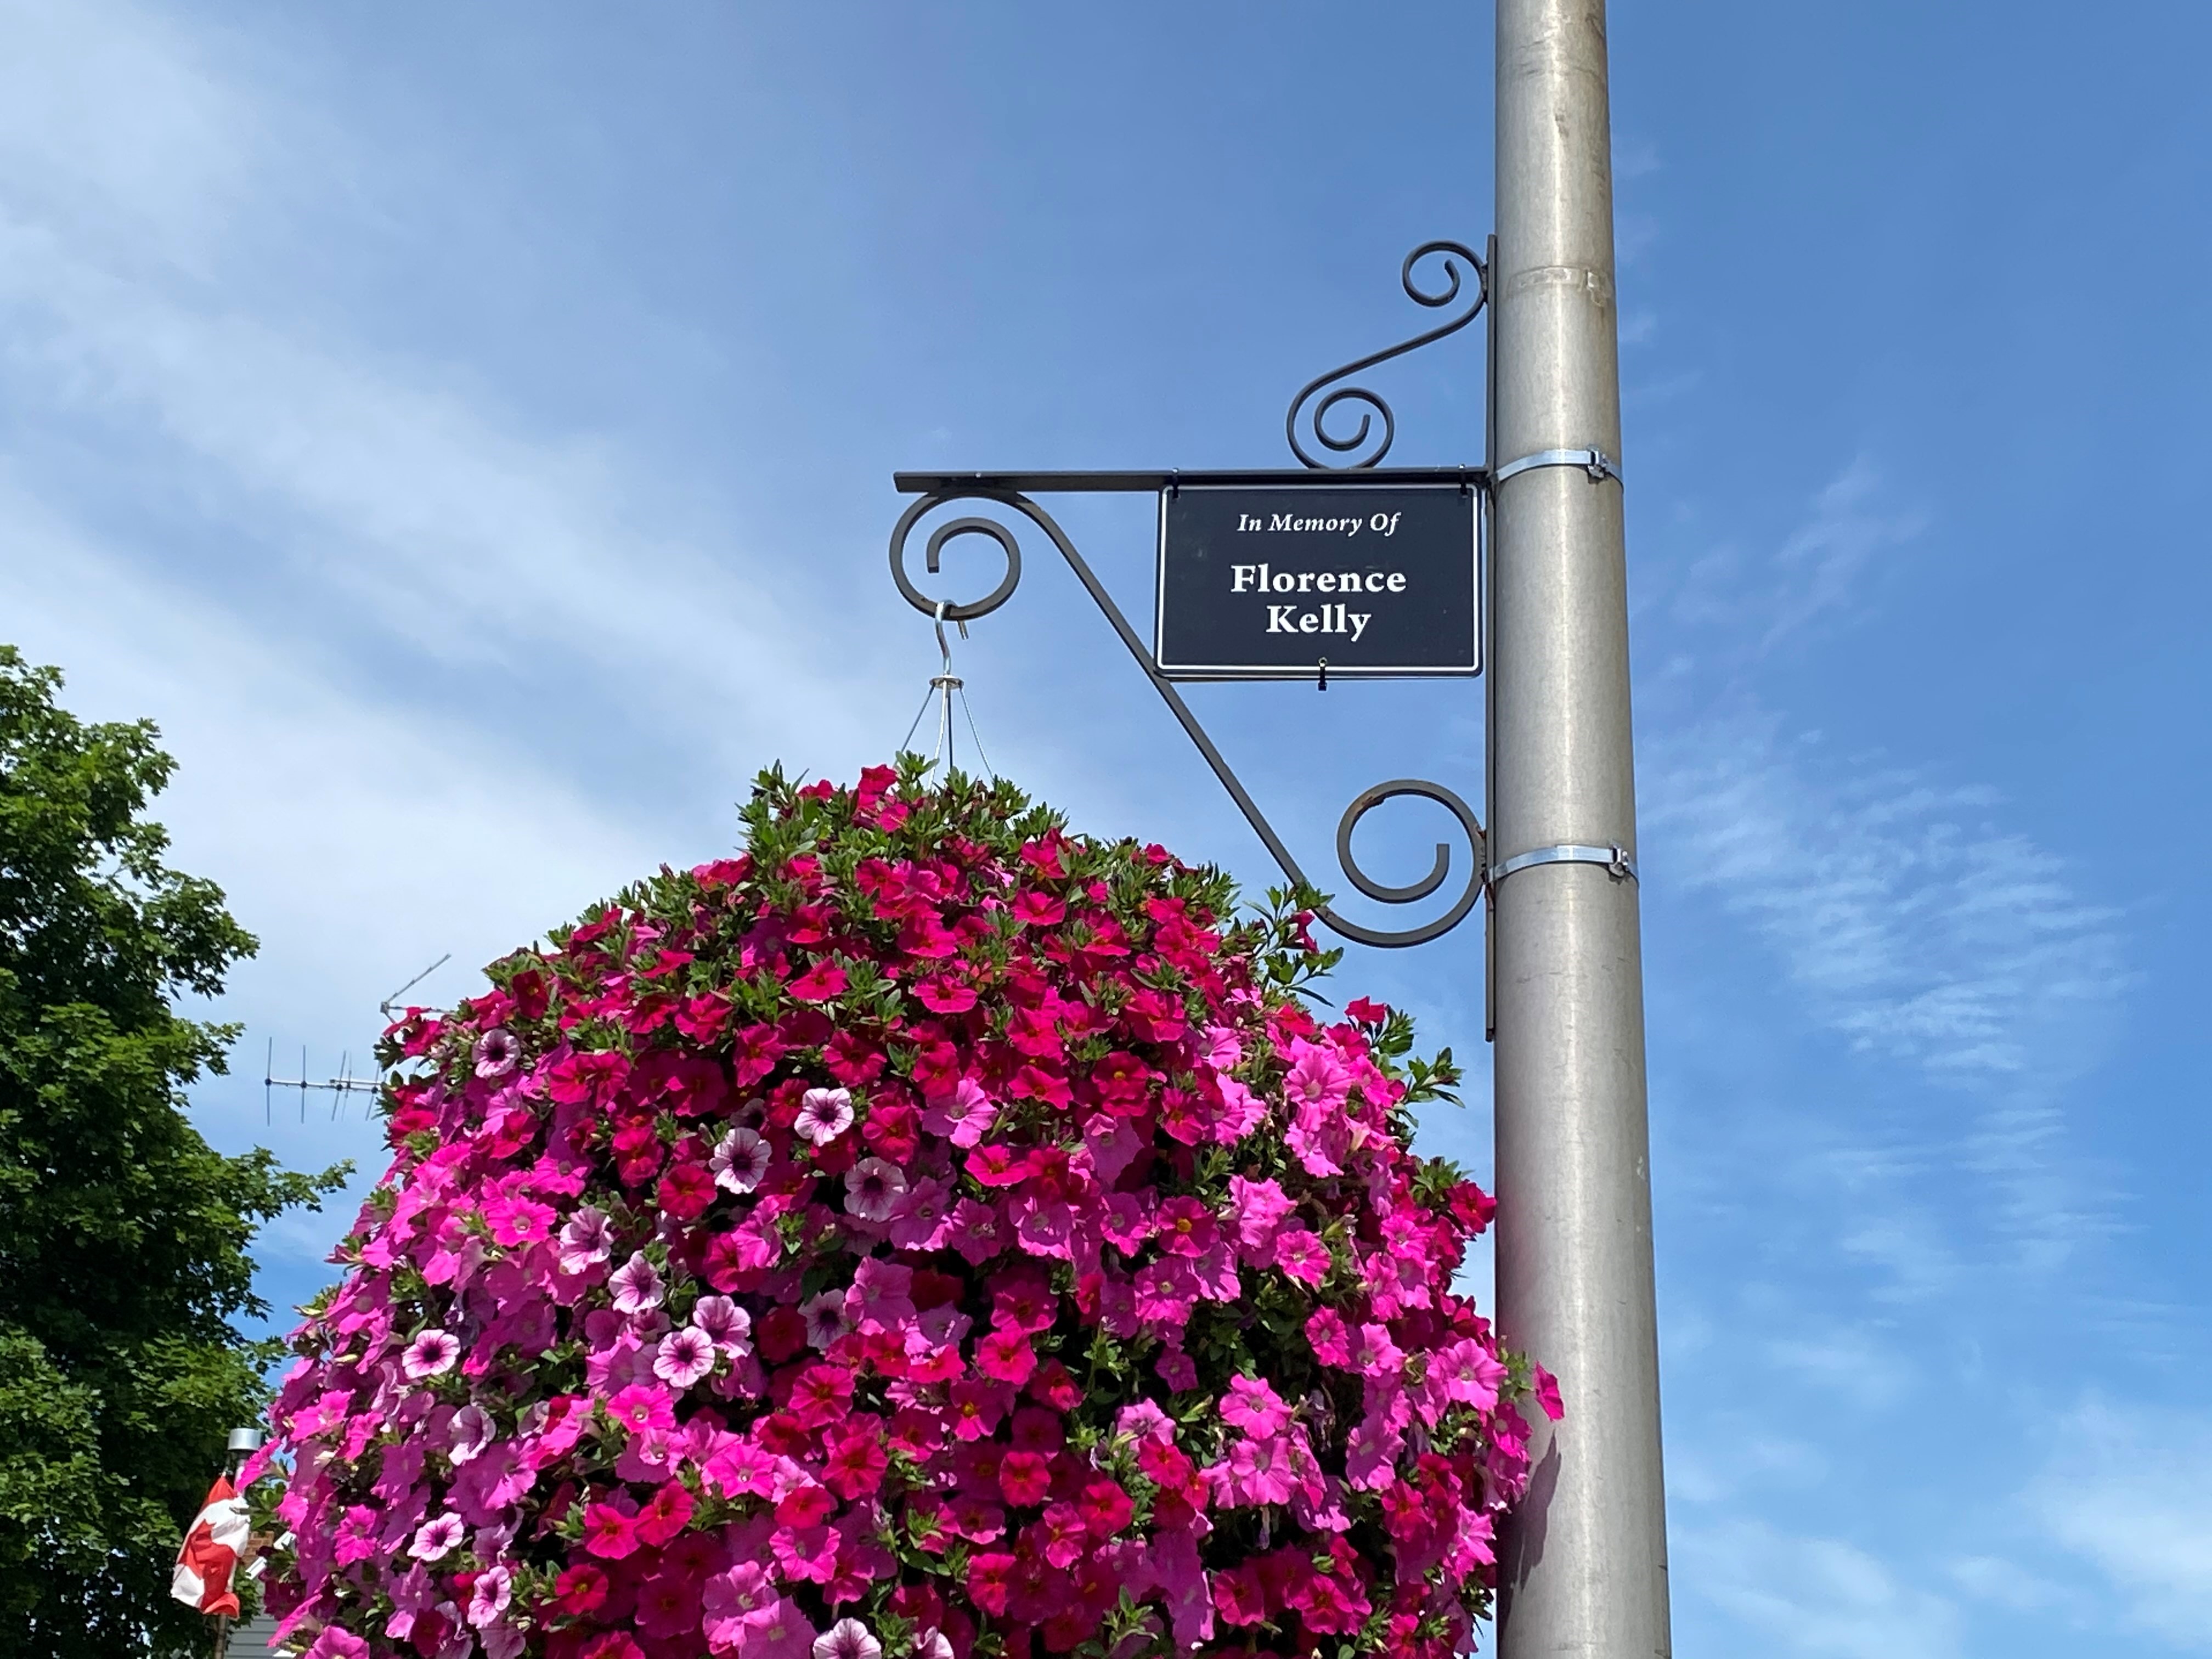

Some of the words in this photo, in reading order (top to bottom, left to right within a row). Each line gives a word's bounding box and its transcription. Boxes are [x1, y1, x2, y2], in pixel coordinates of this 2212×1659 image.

[1237, 514, 1262, 531] In
[1267, 514, 1362, 537] Memory
[1370, 511, 1402, 537] Of
[1231, 563, 1406, 592] Florence
[1266, 603, 1372, 642] Kelly
